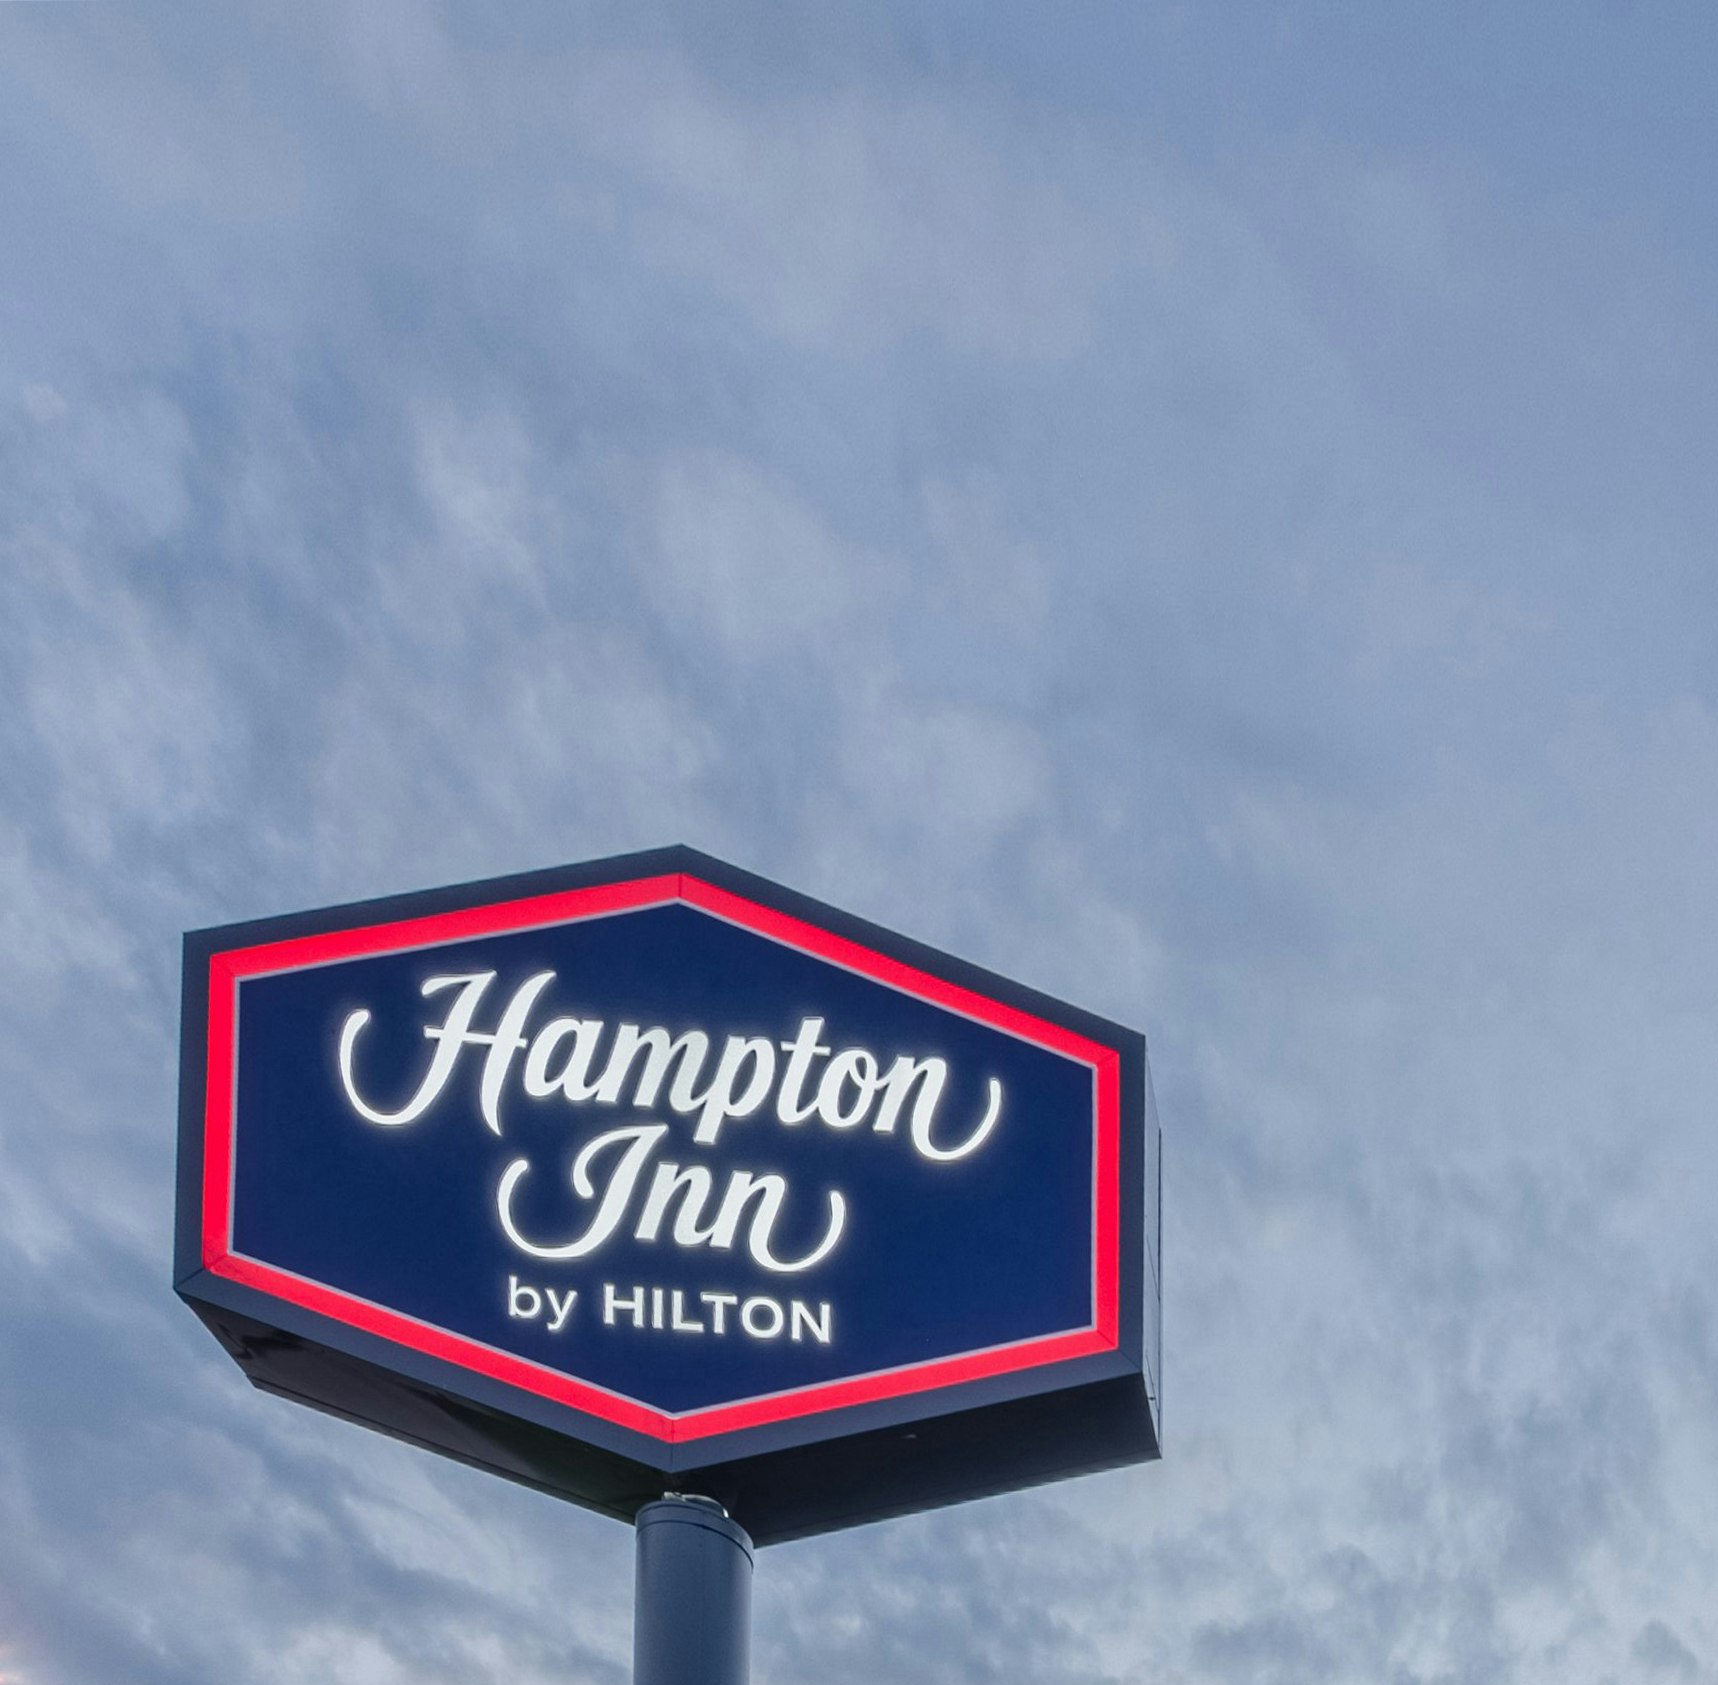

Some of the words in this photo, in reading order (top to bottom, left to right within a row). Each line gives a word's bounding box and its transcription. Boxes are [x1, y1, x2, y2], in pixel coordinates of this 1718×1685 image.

[340, 971, 1002, 1161] Hampton
[498, 1125, 846, 1272] Inn
[508, 1275, 578, 1331] by
[603, 1284, 831, 1344] HILTON
